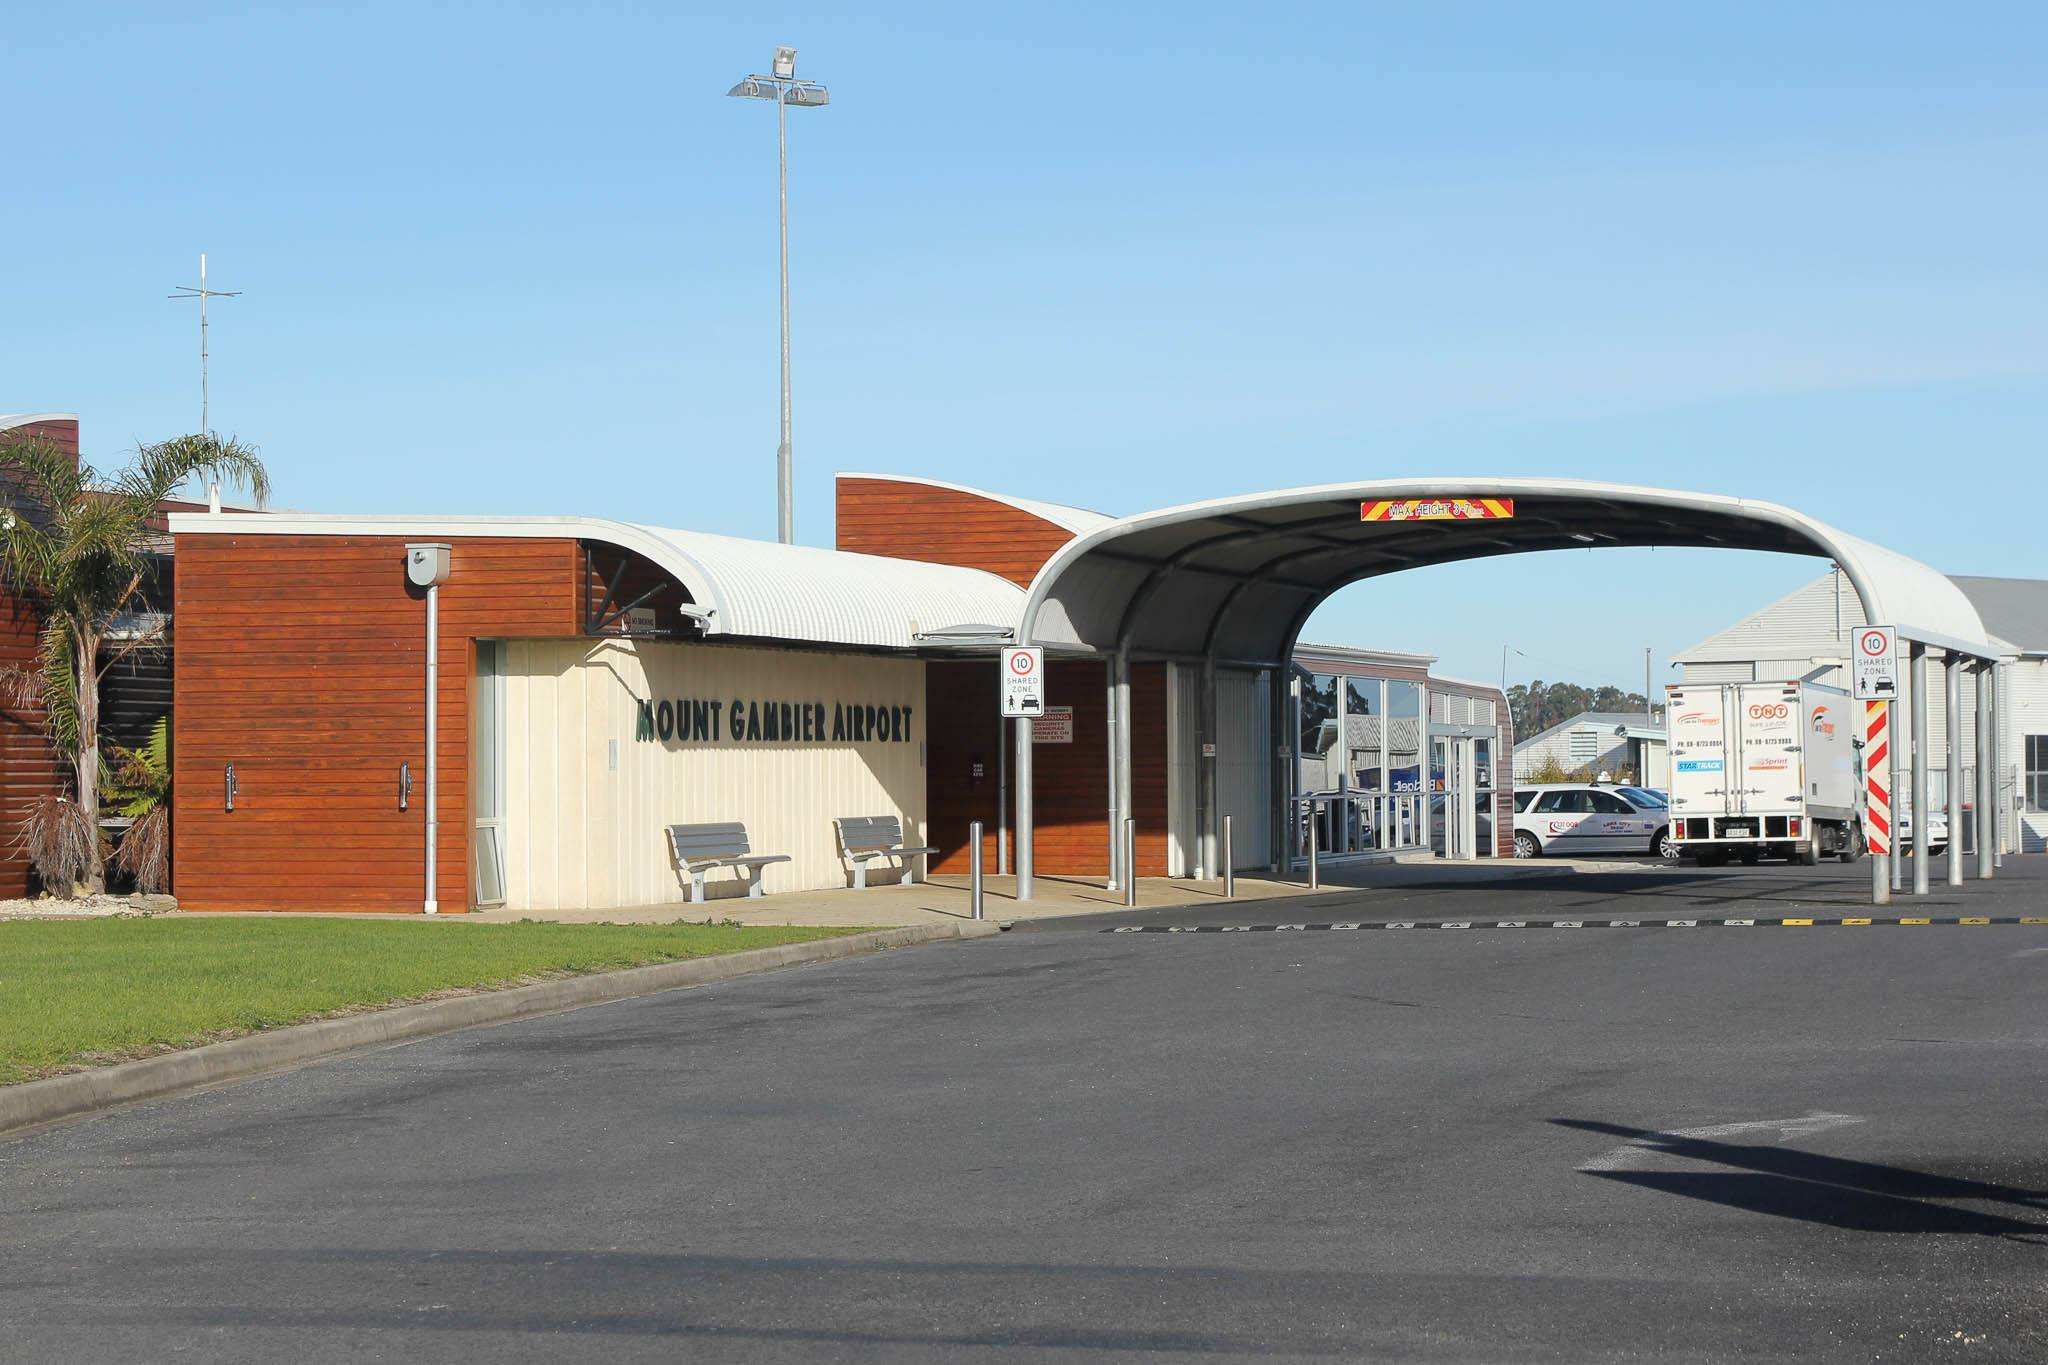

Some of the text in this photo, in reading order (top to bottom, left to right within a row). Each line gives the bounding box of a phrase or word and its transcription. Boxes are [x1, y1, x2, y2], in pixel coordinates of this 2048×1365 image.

[1388, 505, 1413, 516] MAX.
[1416, 503, 1450, 516] HEIGHT
[1868, 638, 1881, 650] 10
[1017, 658, 1028, 669] 10
[1857, 658, 1893, 666] SHARED
[1864, 667, 1887, 675] ZONE
[1007, 677, 1039, 685] SHARED
[1012, 685, 1033, 693] ZONE
[1750, 706, 1787, 717] TNT
[636, 699, 913, 743] MOUNT GAMBIER AIRPORT
